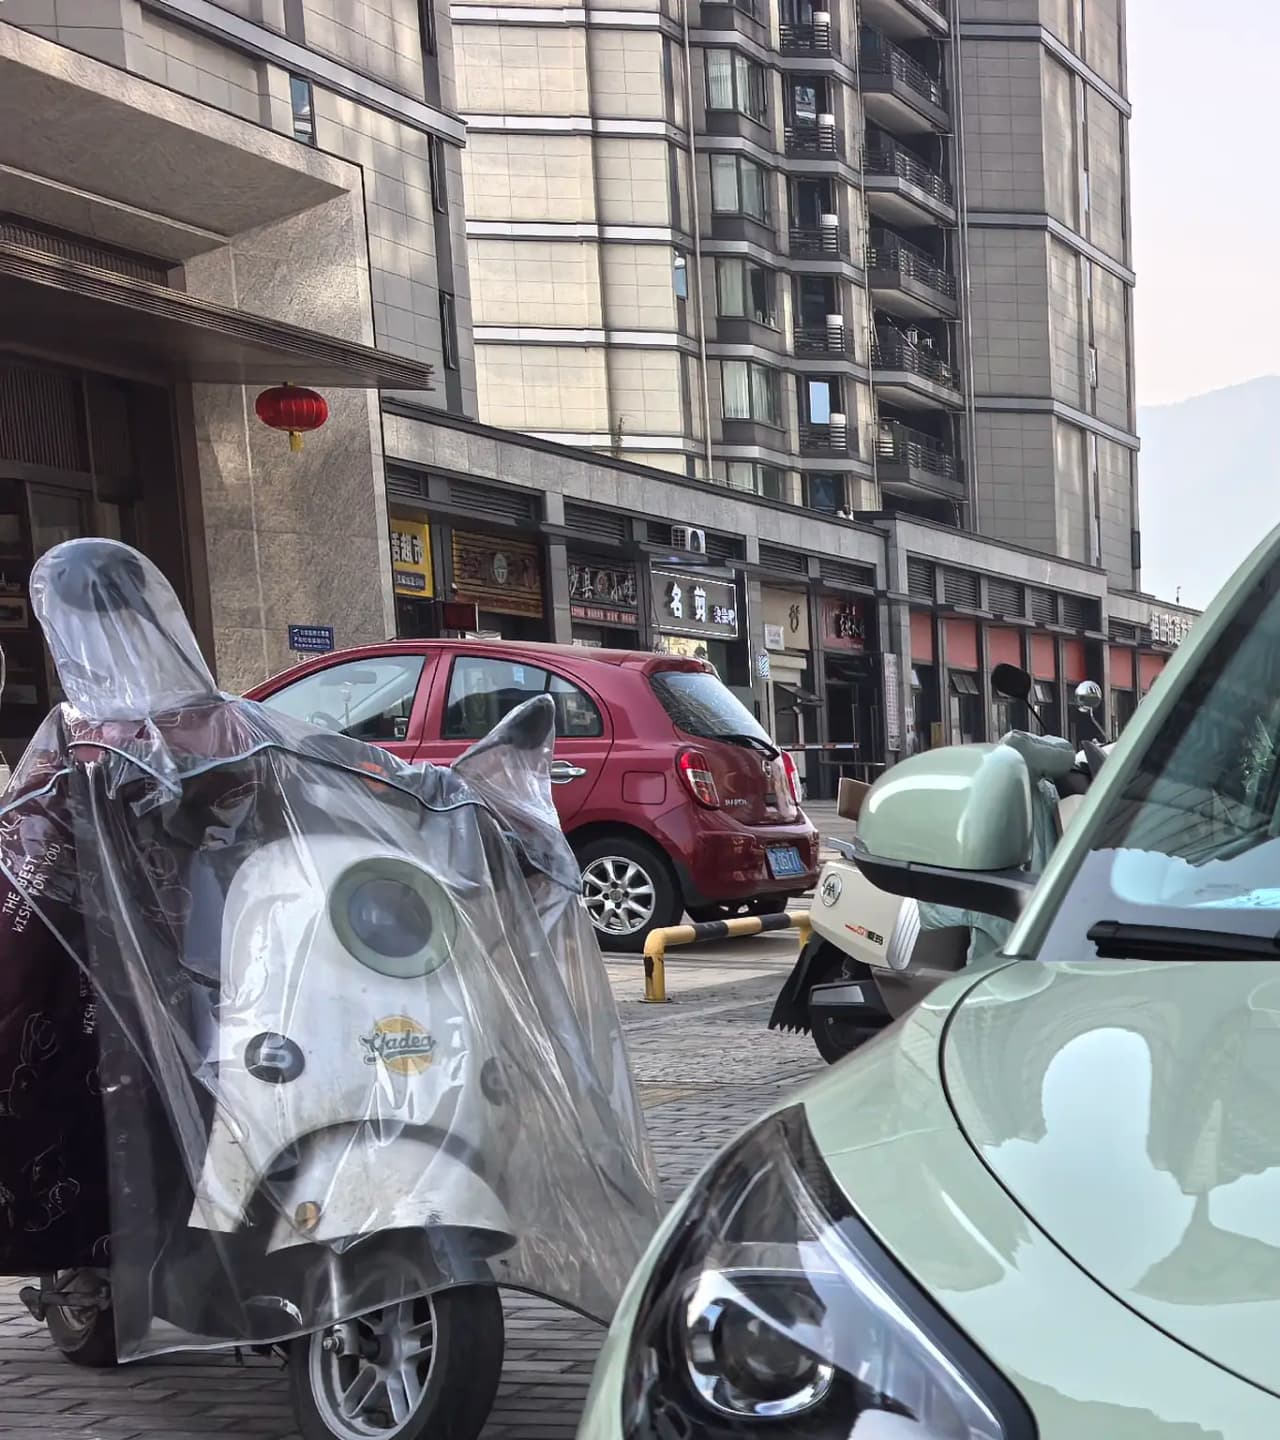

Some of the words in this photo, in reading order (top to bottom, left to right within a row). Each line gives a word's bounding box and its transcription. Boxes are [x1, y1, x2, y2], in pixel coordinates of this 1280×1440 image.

[2, 891, 20, 914] THE
[17, 854, 39, 888] BEST
[12, 901, 33, 932] WISH
[28, 873, 49, 896] FOR
[42, 843, 61, 866] YOU
